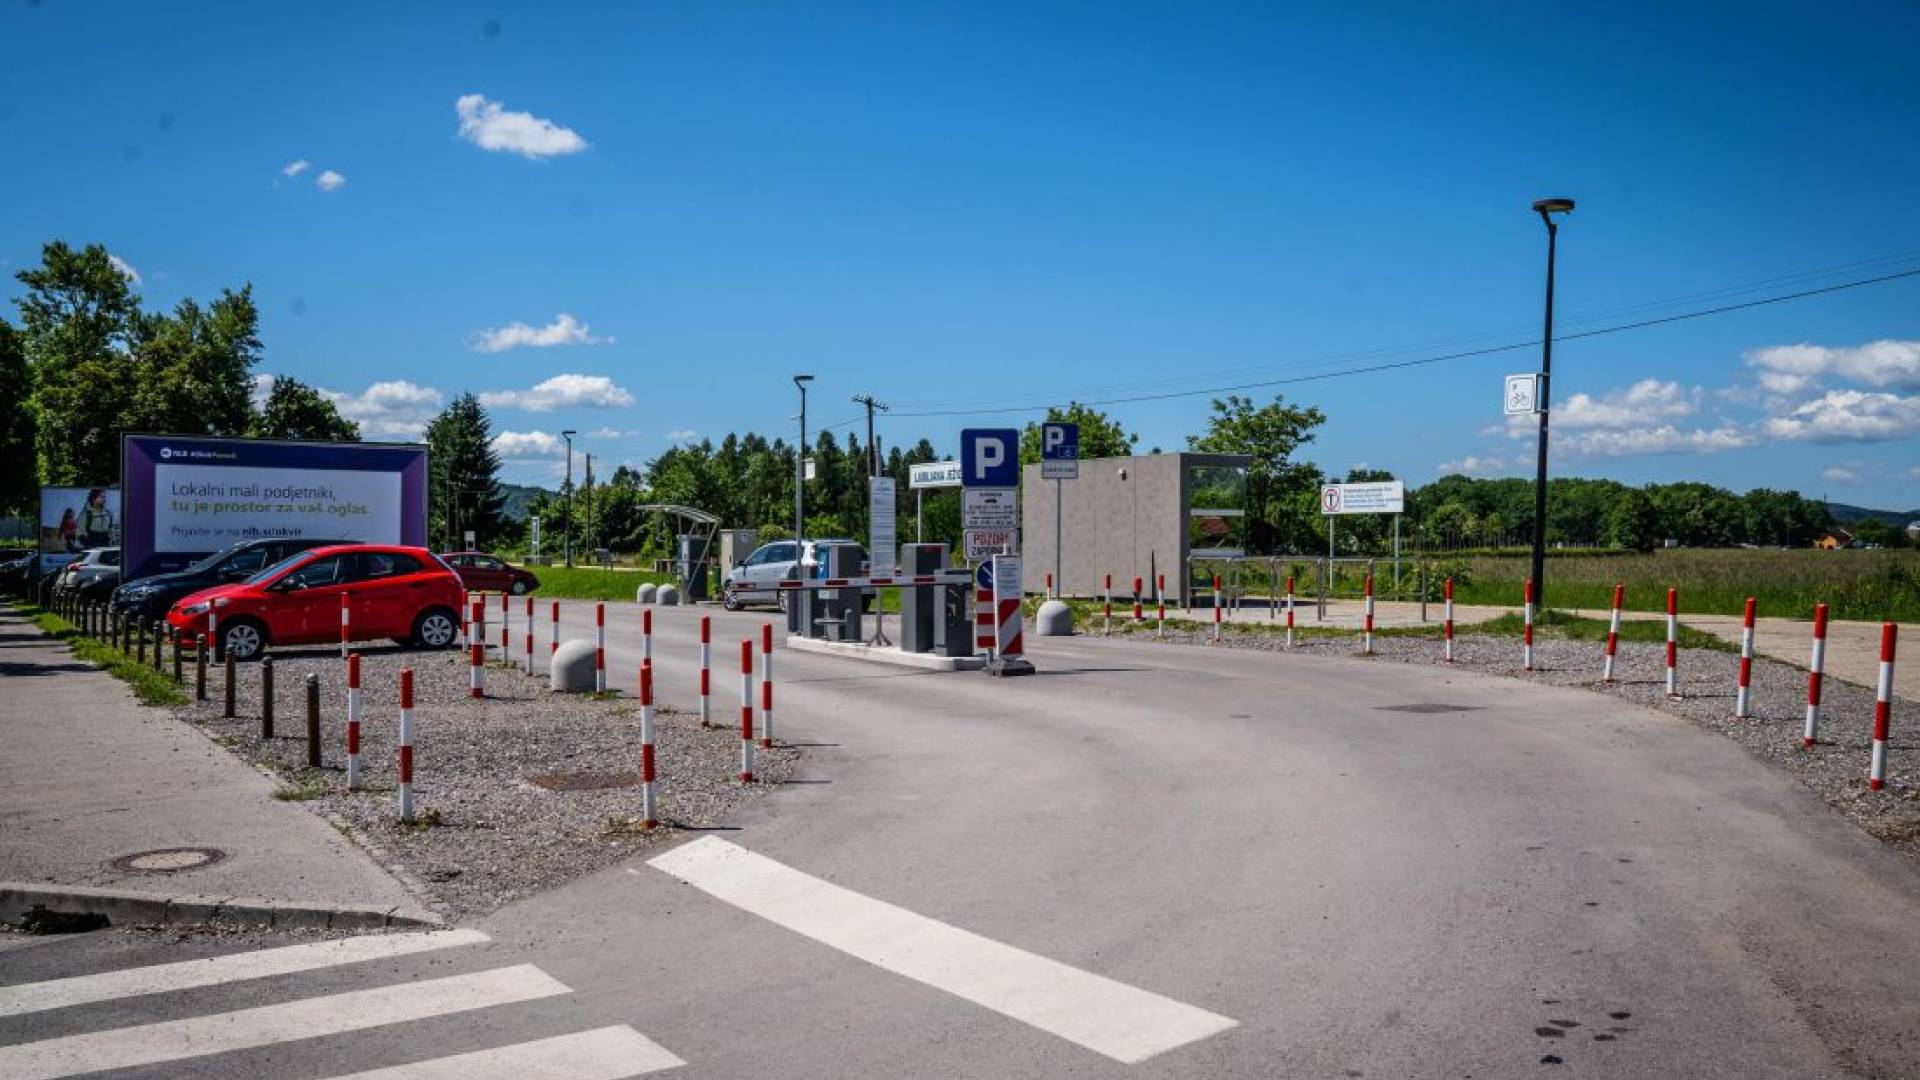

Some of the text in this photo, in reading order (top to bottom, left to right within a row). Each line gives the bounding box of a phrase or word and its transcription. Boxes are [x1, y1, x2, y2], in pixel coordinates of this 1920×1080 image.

[1046, 426, 1063, 453] P
[975, 437, 1005, 479] P
[172, 481, 336, 501] Lokalni mali podjetniki,
[171, 501, 188, 512] tu
[194, 500, 209, 514] je
[214, 503, 271, 514] prostor
[276, 504, 293, 513] za
